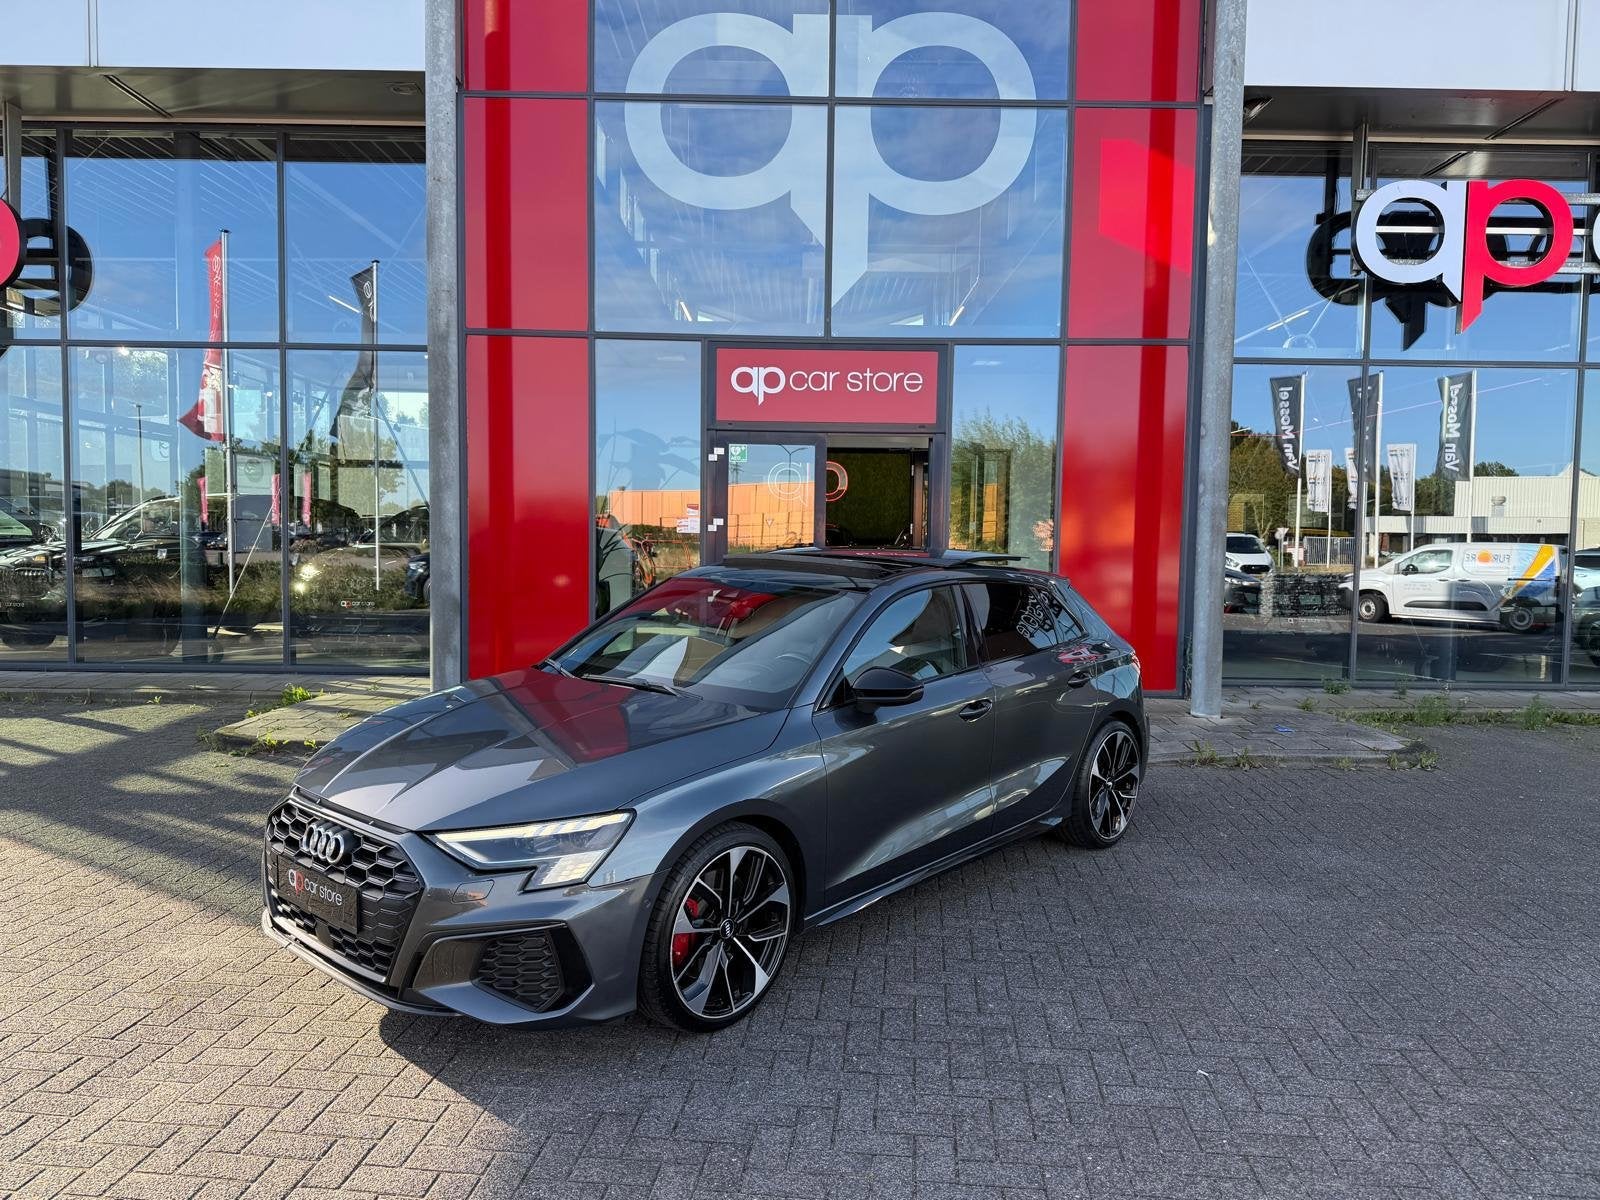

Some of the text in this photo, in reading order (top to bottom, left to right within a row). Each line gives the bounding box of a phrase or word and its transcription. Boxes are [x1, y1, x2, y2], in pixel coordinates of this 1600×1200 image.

[790, 371, 840, 391] car
[847, 368, 923, 392] store
[304, 878, 318, 894] car
[320, 886, 342, 906] store
